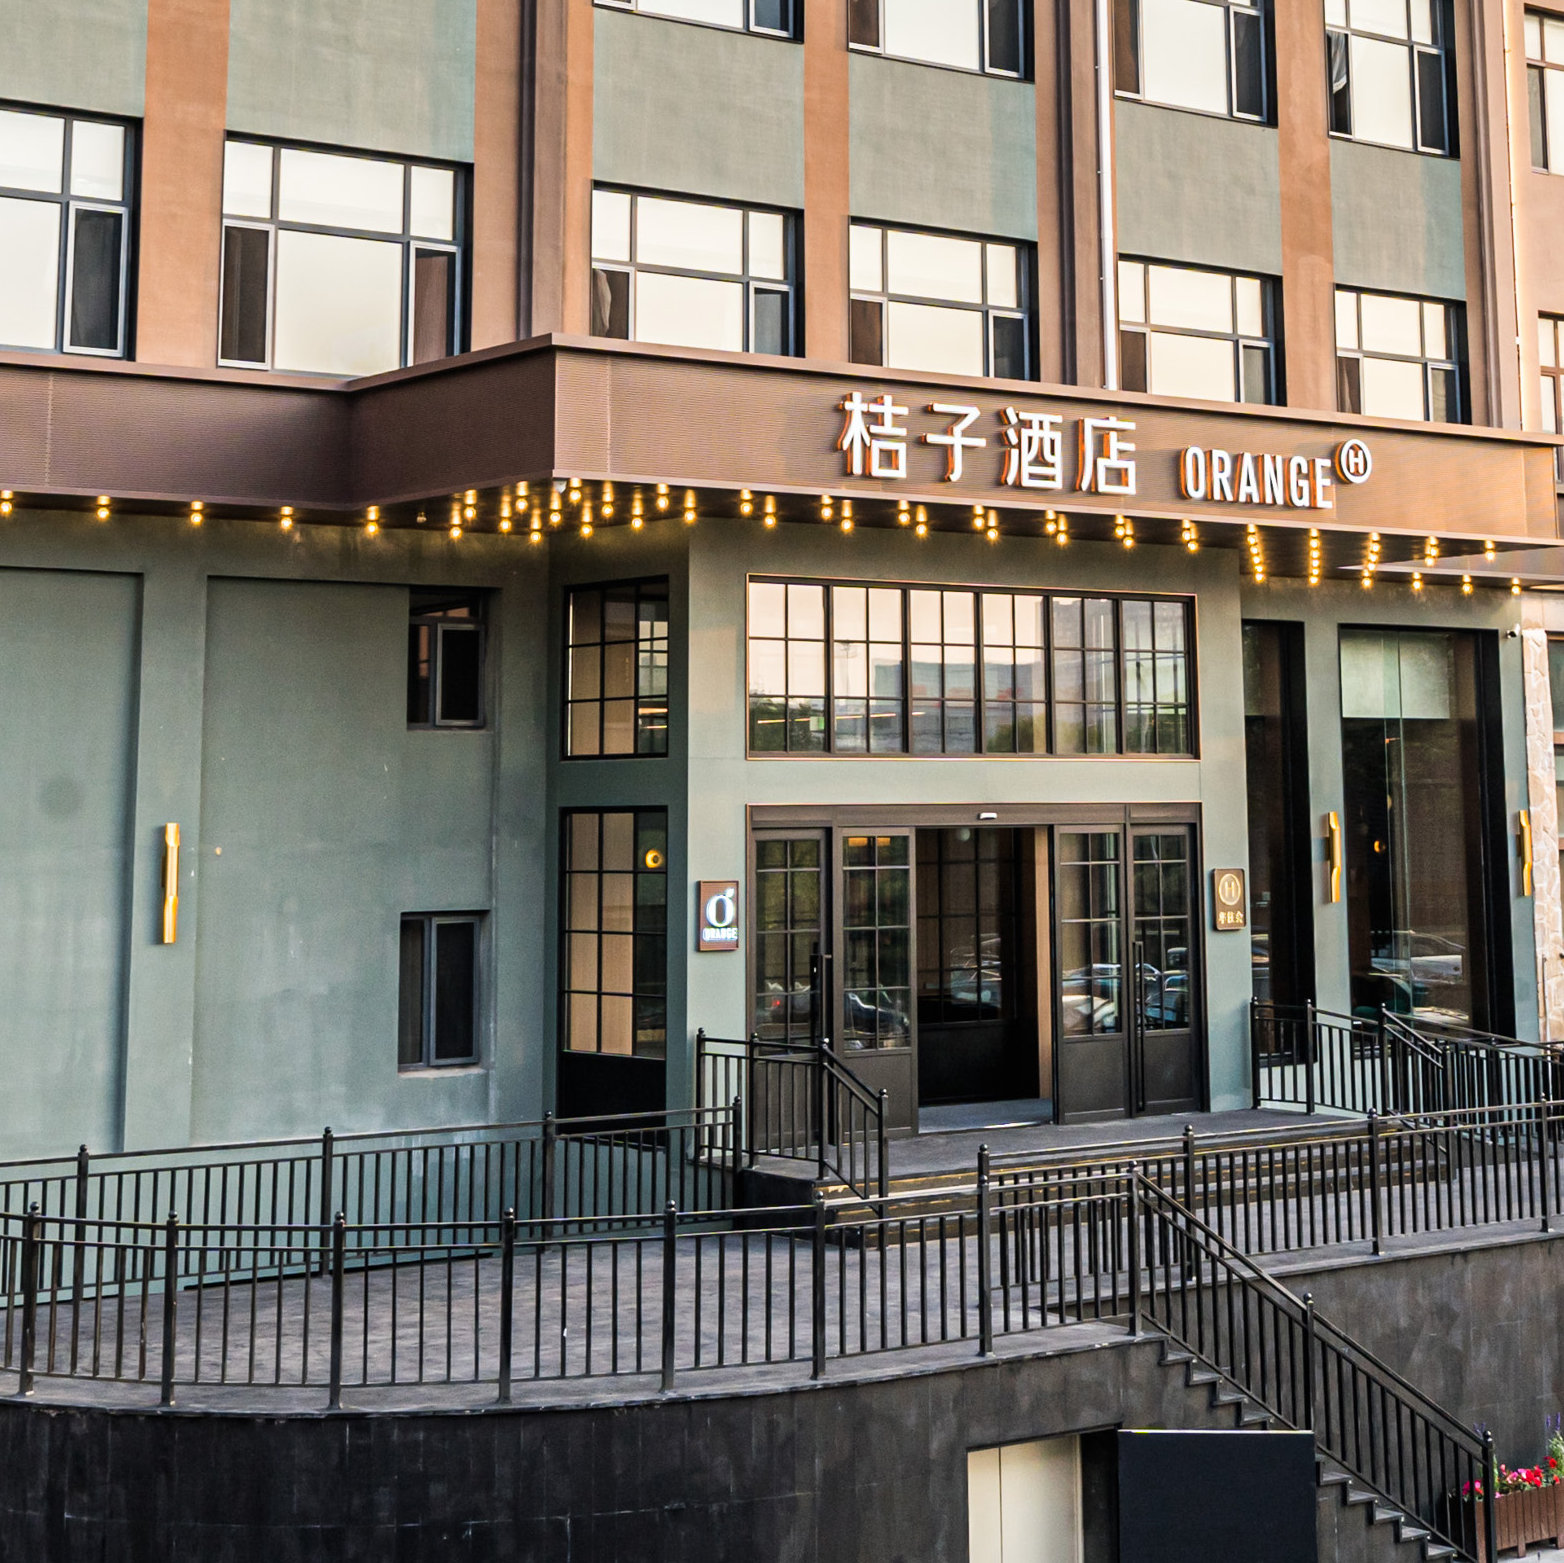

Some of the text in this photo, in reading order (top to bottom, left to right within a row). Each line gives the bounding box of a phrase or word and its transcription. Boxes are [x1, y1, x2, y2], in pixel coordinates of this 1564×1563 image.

[838, 392, 1137, 495] 桔子酒店
[1181, 445, 1333, 509] ORANGE
